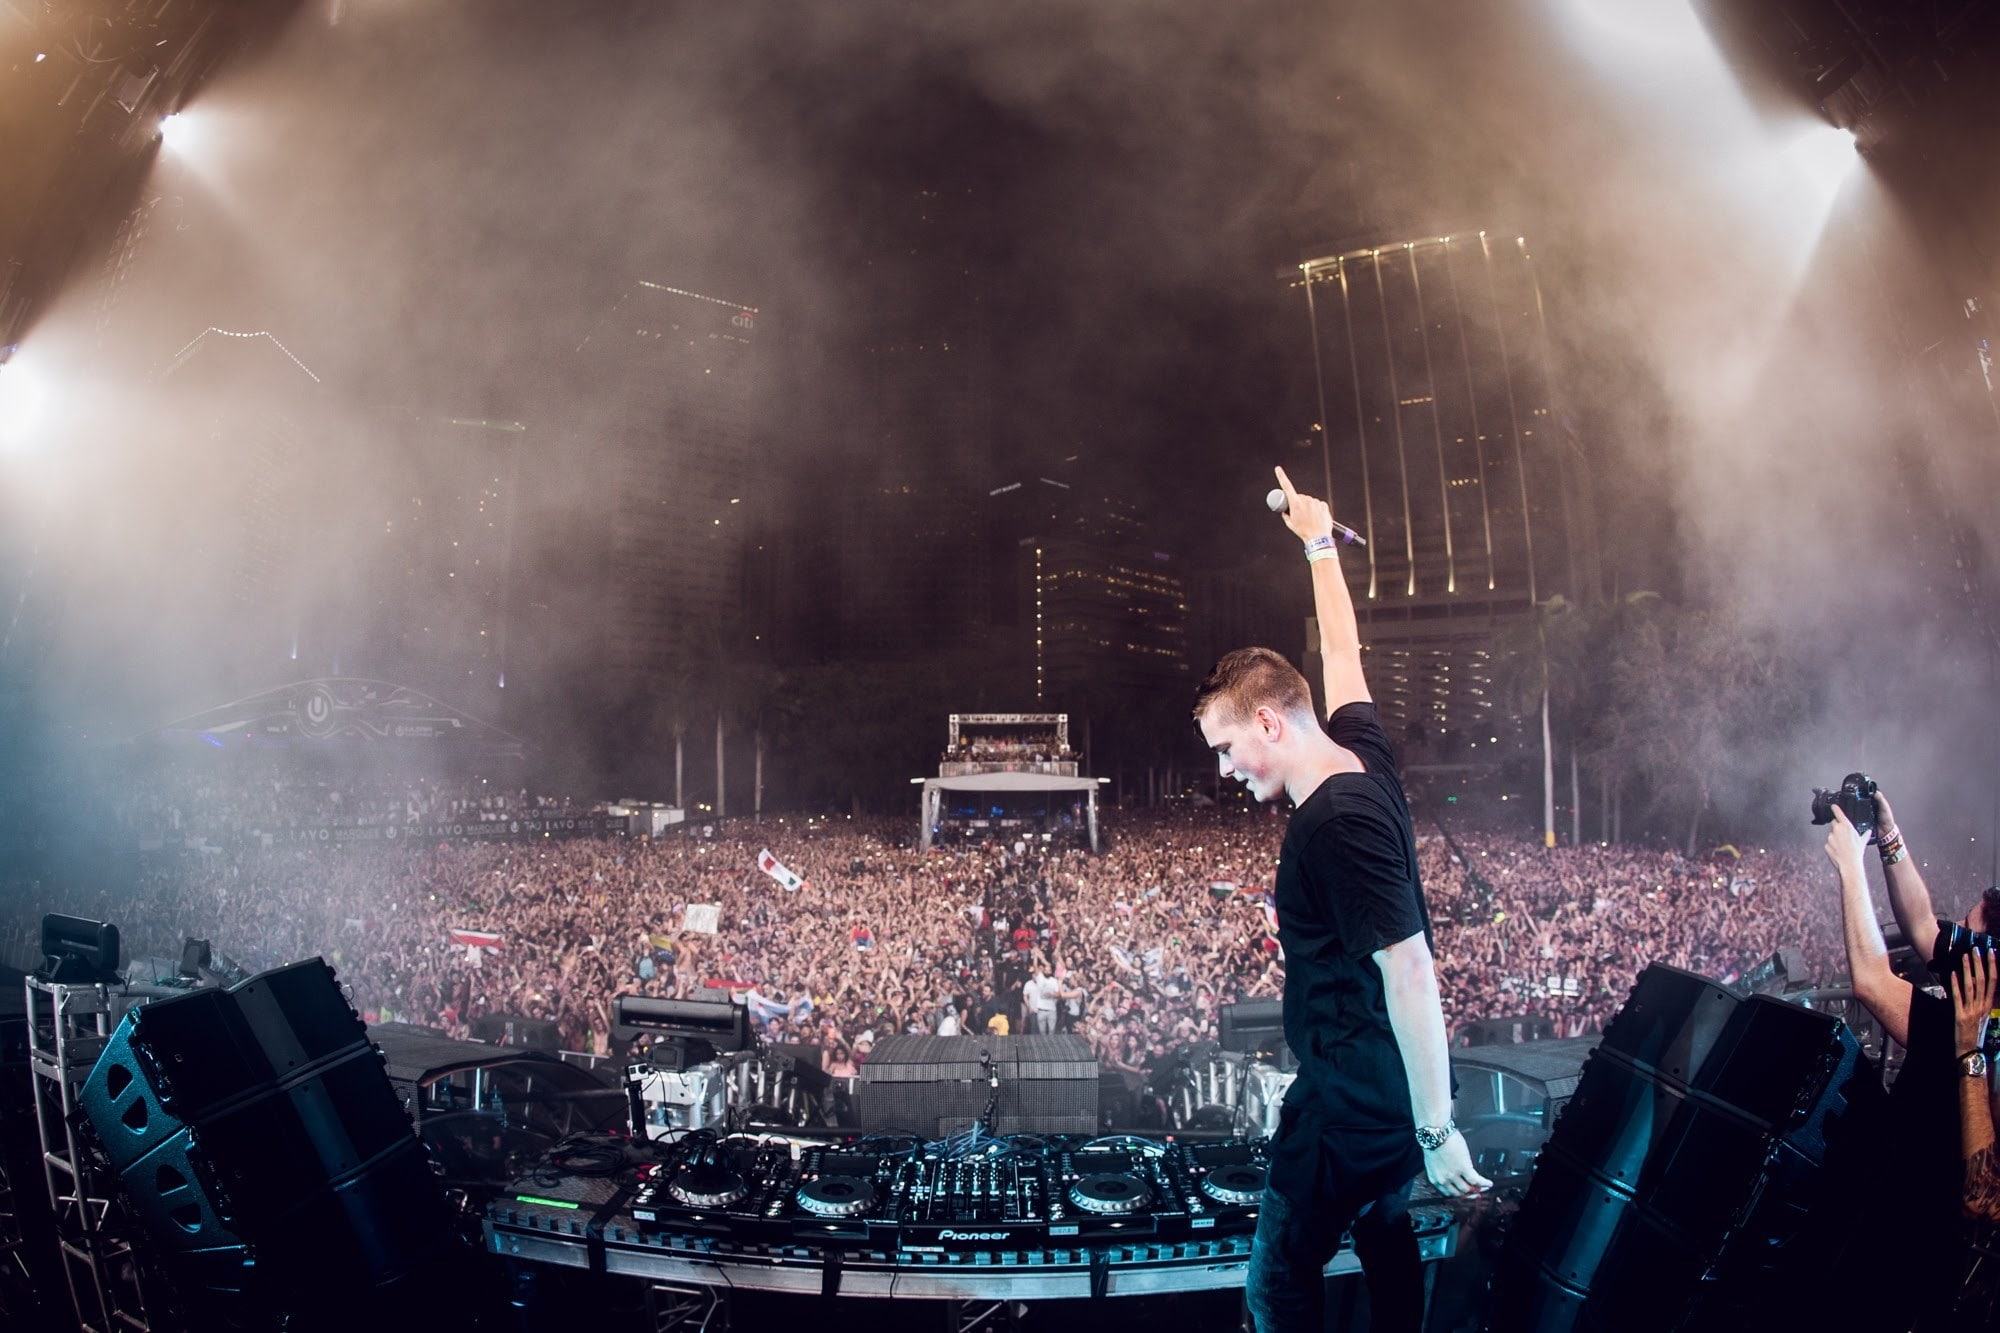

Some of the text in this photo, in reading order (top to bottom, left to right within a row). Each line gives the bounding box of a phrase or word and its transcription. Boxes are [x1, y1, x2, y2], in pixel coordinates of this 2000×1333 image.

[731, 315, 754, 329] citi
[290, 829, 329, 841] LAVO
[428, 824, 462, 836] LAVO
[545, 820, 575, 830] LAVO
[938, 1229, 1010, 1240] Pioneer
